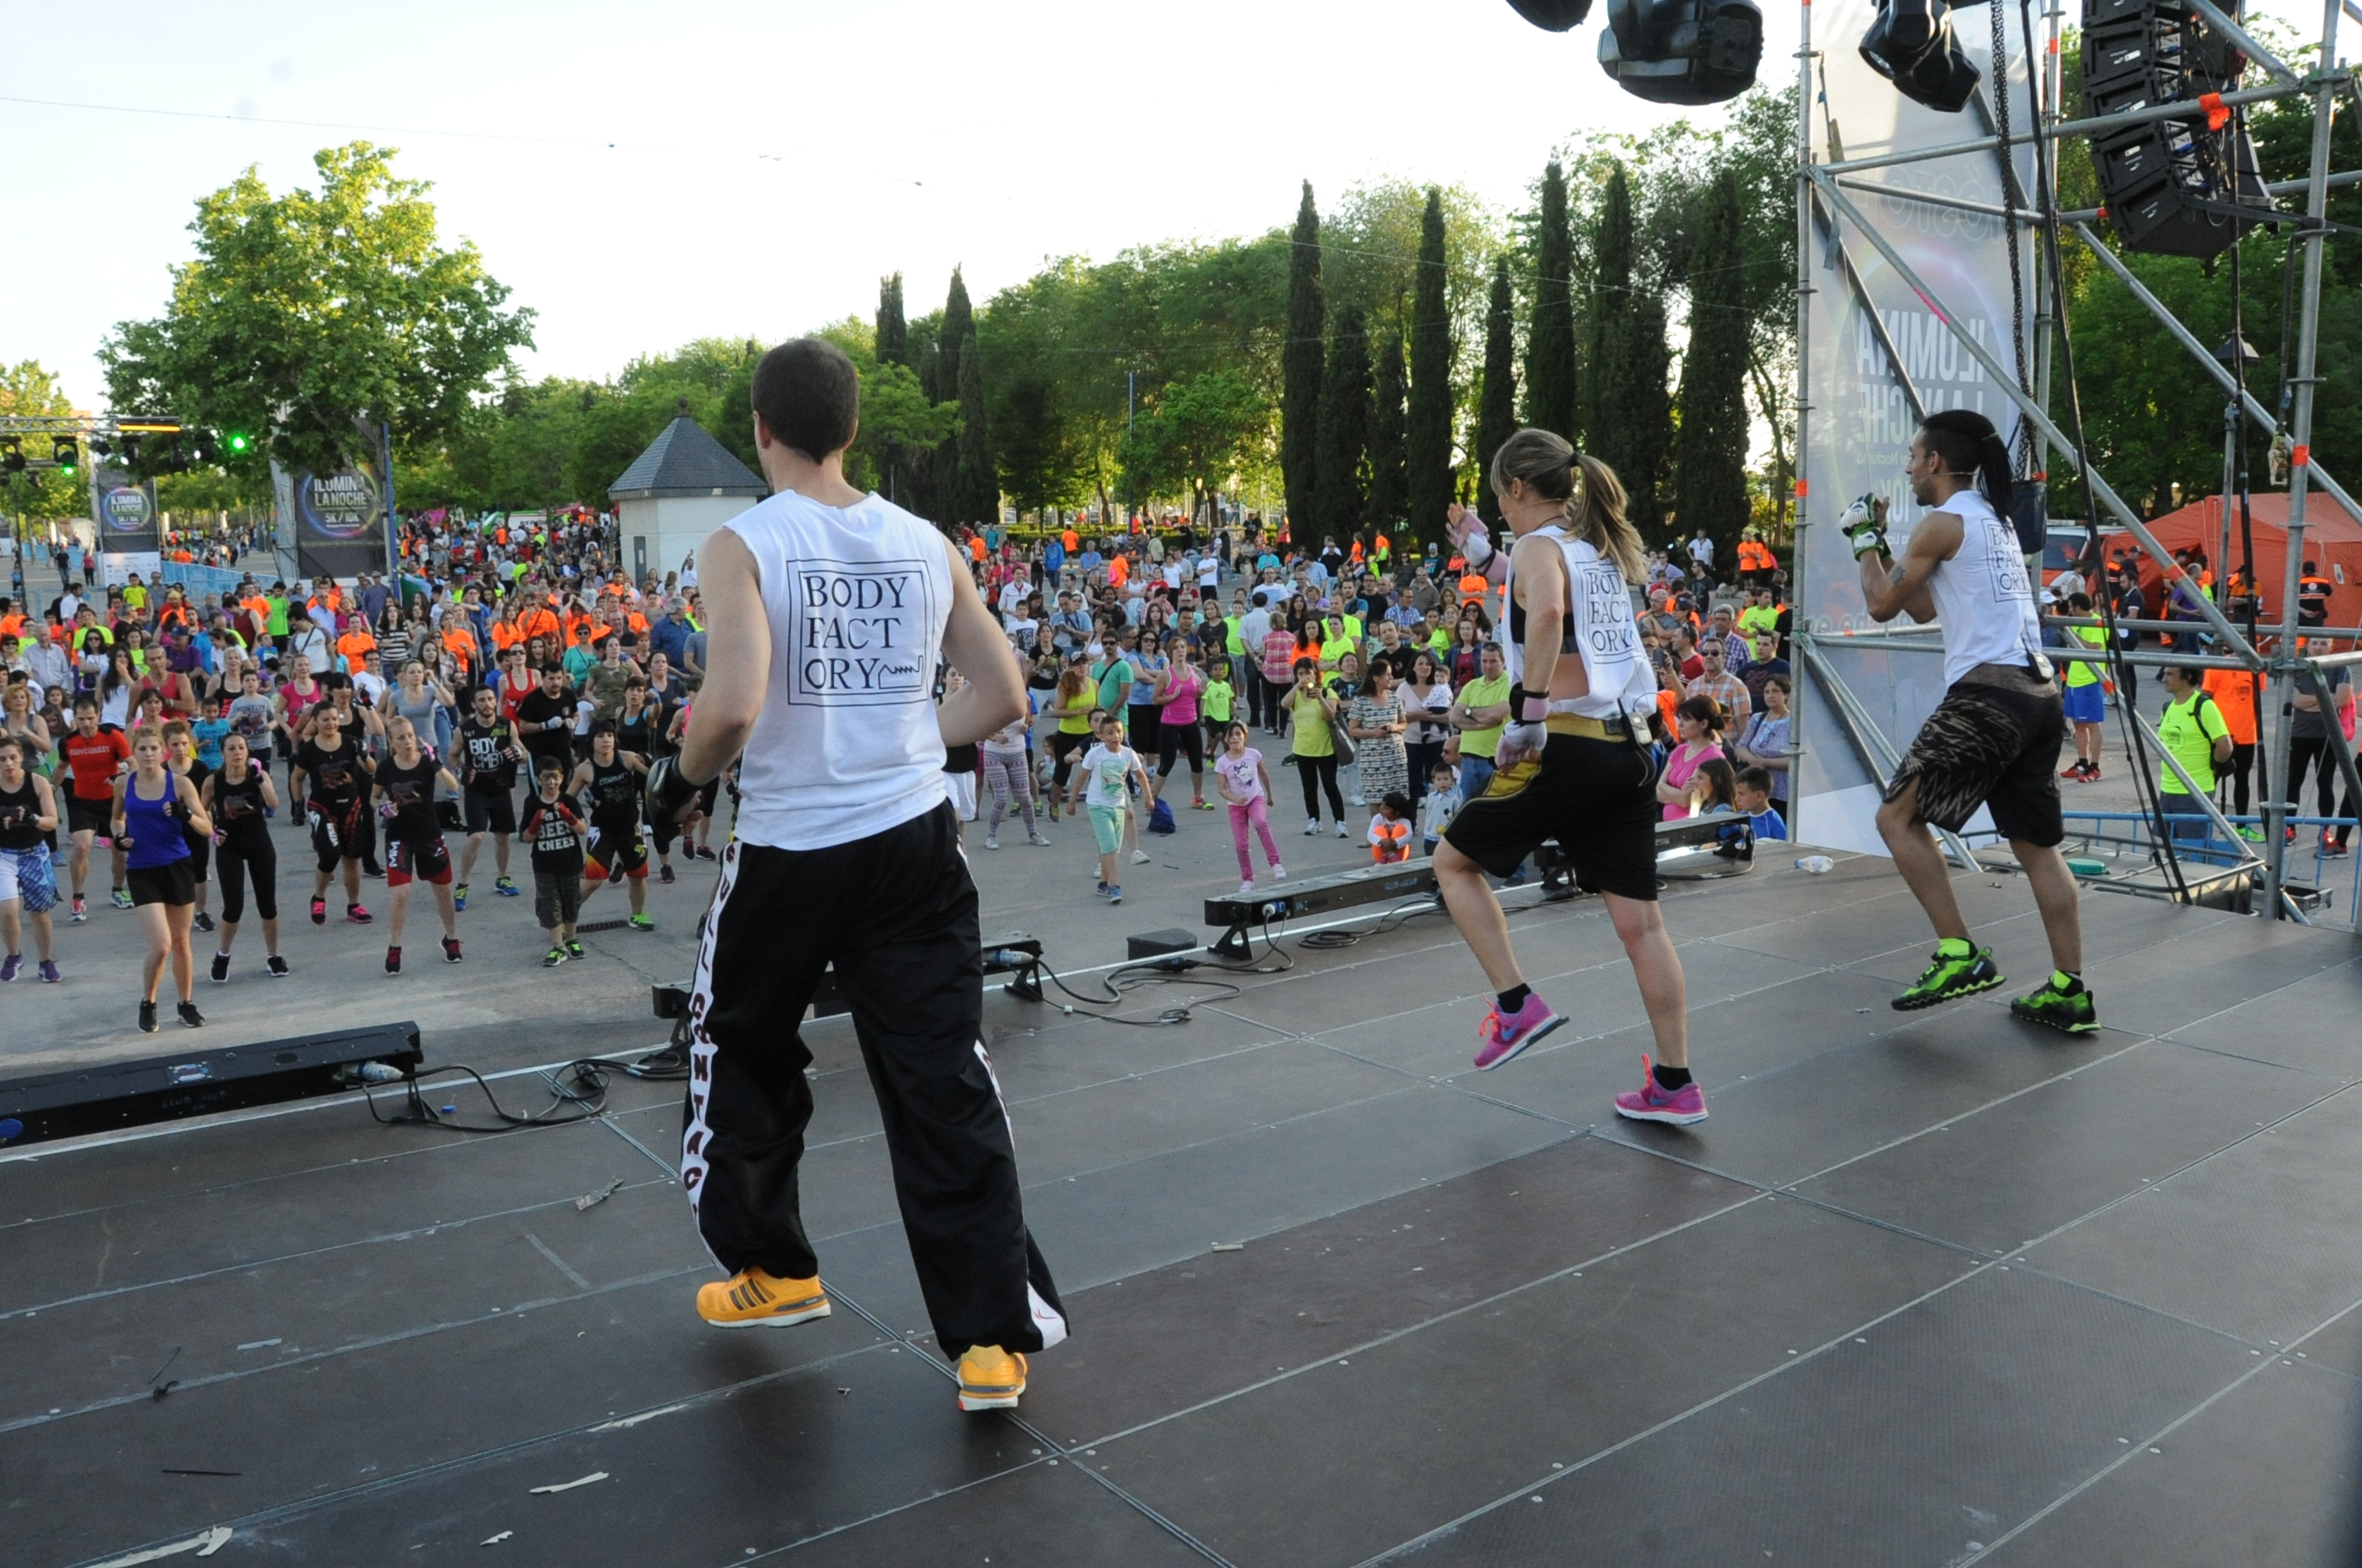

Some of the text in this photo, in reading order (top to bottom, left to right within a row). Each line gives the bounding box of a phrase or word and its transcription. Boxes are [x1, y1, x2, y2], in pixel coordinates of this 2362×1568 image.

[110, 495, 143, 504] ILUMINA
[315, 491, 367, 506] LA NOCHE
[1994, 551, 2022, 568] FAC
[803, 575, 909, 609] BODY
[1587, 572, 1622, 595] BOD
[804, 617, 902, 649] FACT
[1592, 629, 1632, 652] ORY
[804, 658, 880, 689] ORY
[538, 836, 574, 851] KNEES
